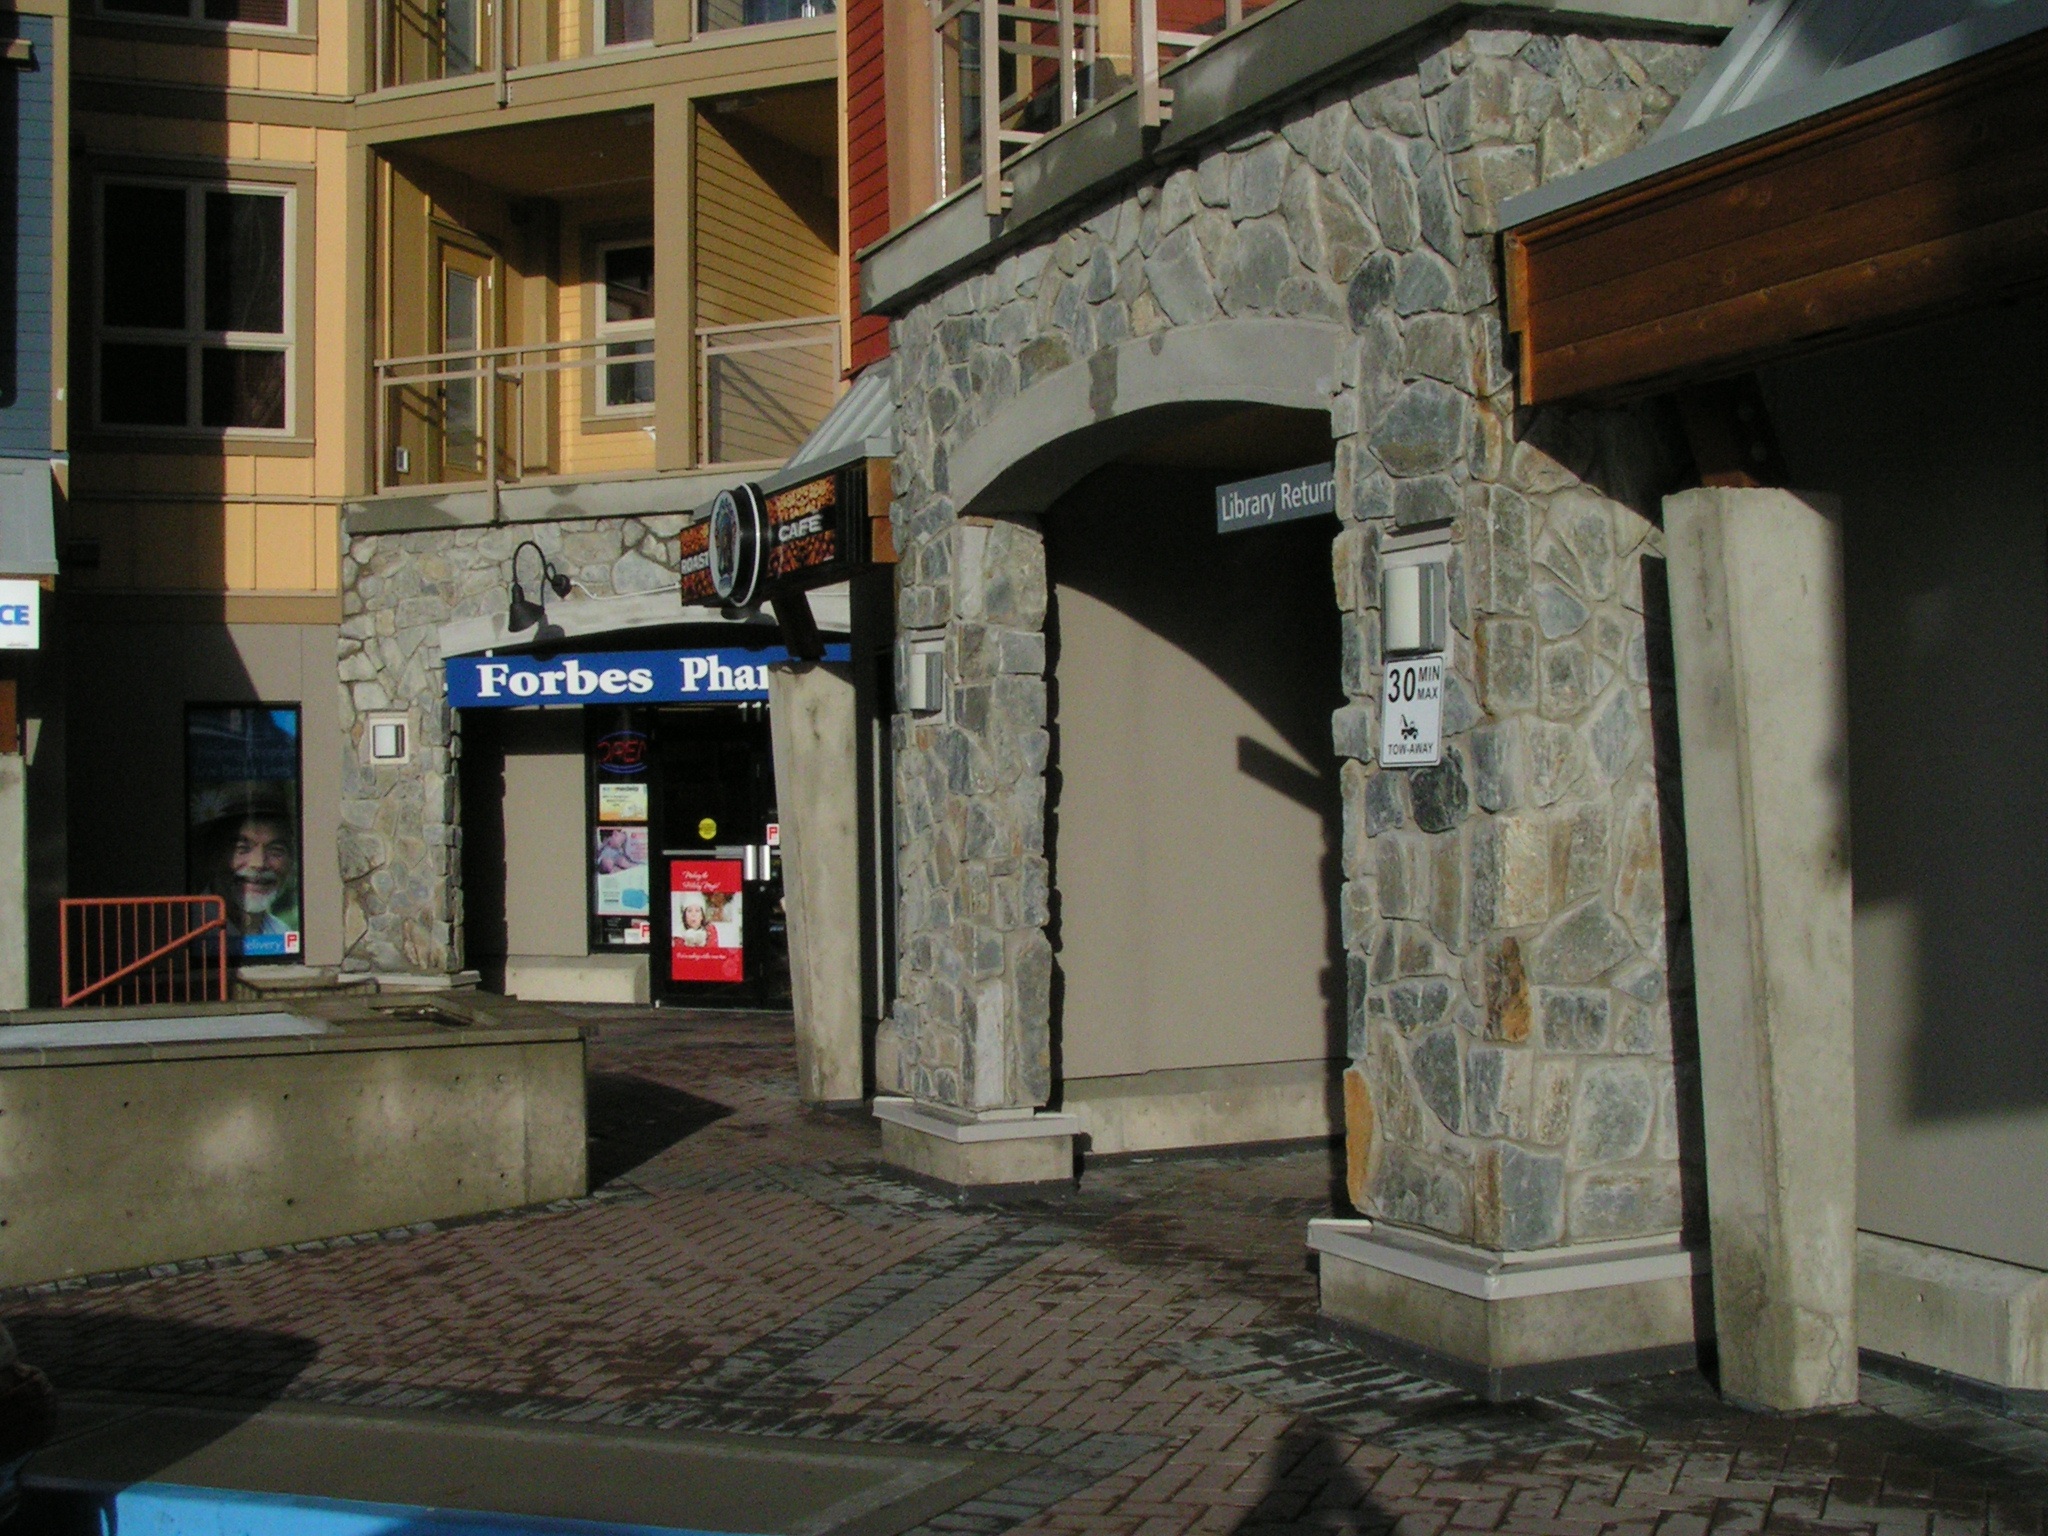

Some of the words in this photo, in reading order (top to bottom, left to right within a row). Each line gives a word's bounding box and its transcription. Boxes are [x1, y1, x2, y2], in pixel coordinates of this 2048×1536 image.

[1221, 491, 1276, 521] Library
[0, 605, 29, 625] CE
[476, 660, 654, 697] Forbes
[1388, 667, 1416, 703] 30
[1419, 665, 1440, 681] MIN
[1417, 687, 1438, 700] MAX
[1388, 743, 1433, 755] TOW-AWAY
